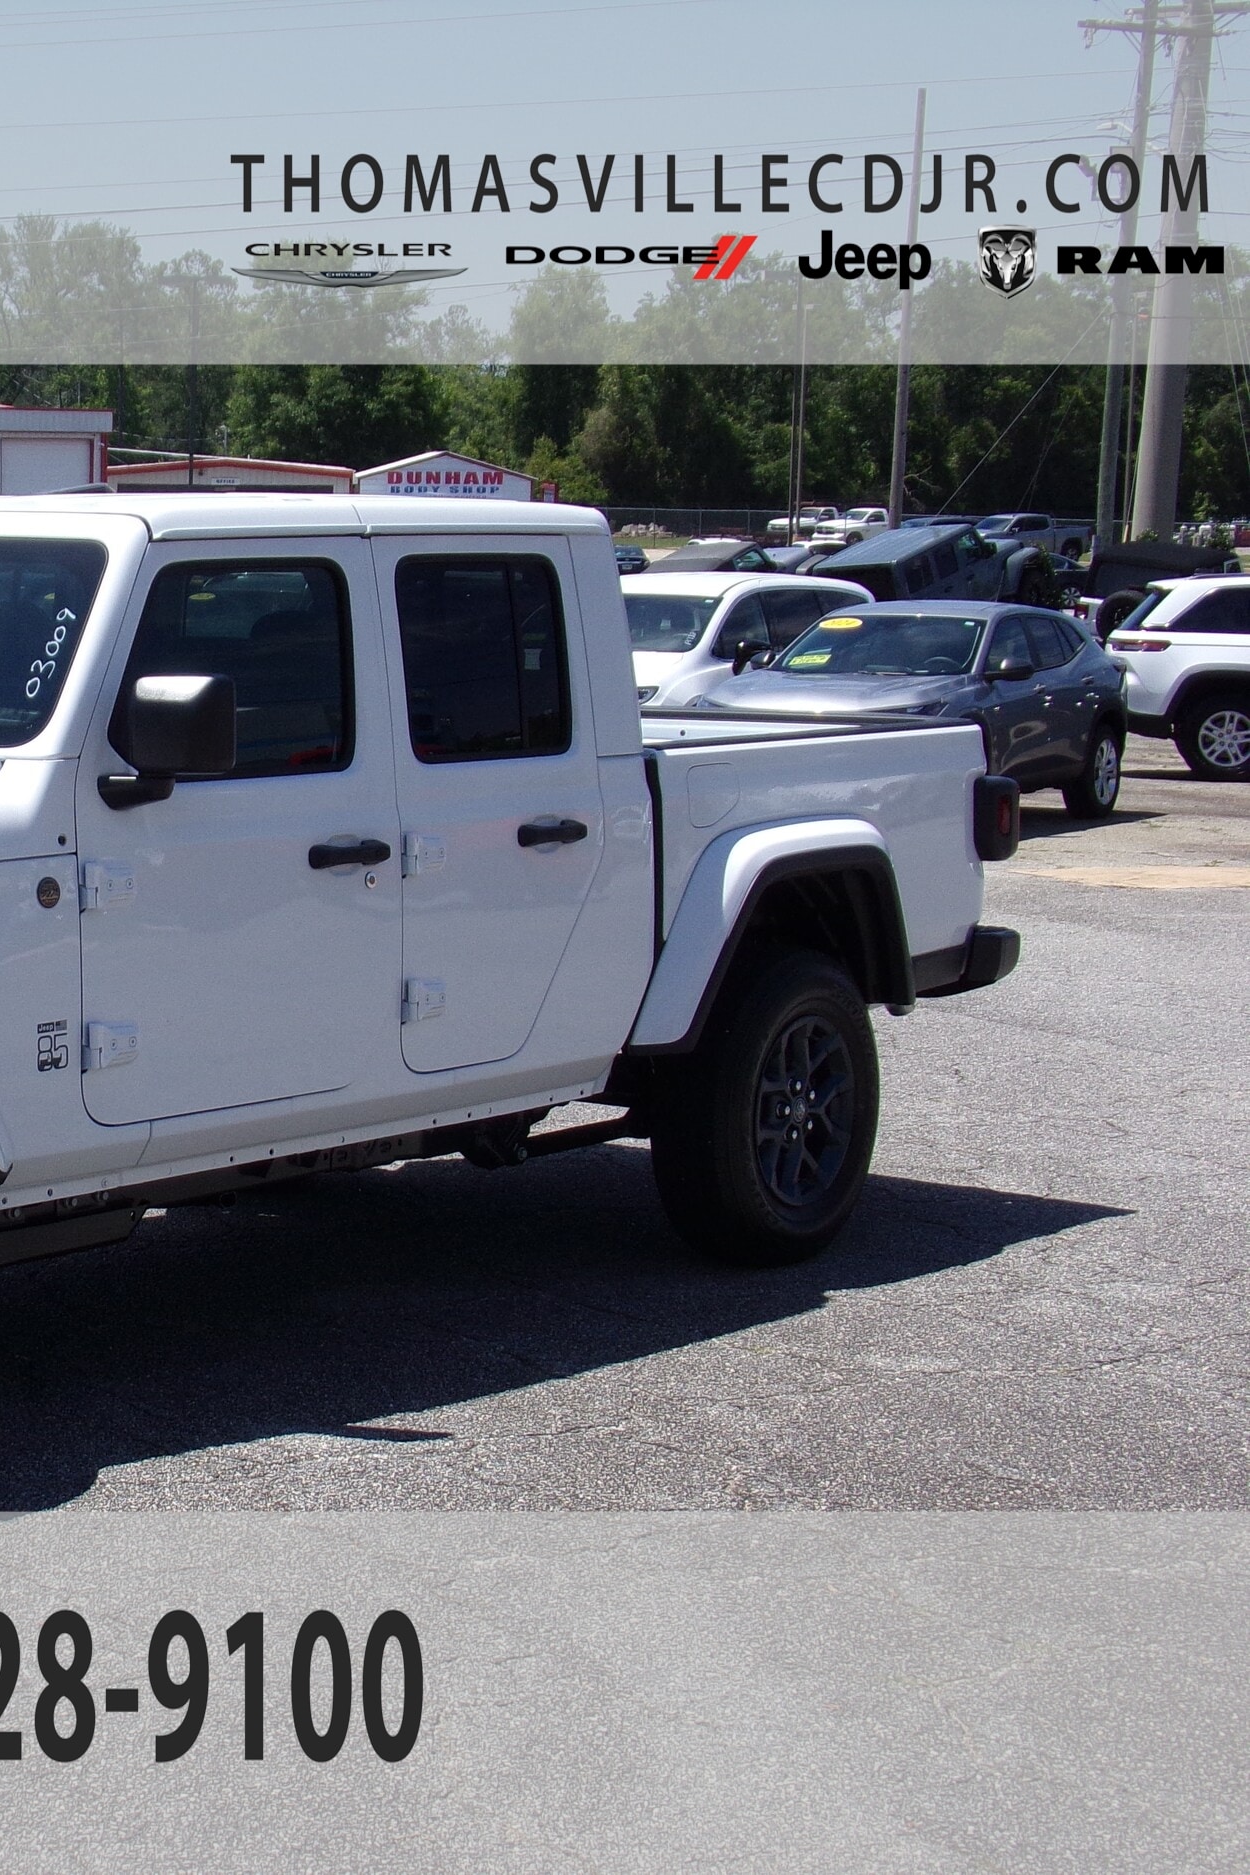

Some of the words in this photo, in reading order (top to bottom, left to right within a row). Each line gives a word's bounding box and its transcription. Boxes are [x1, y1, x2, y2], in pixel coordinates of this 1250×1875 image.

[387, 471, 503, 485] DUNHAM
[25, 607, 76, 698] 03009
[37, 1033, 69, 1072] 85
